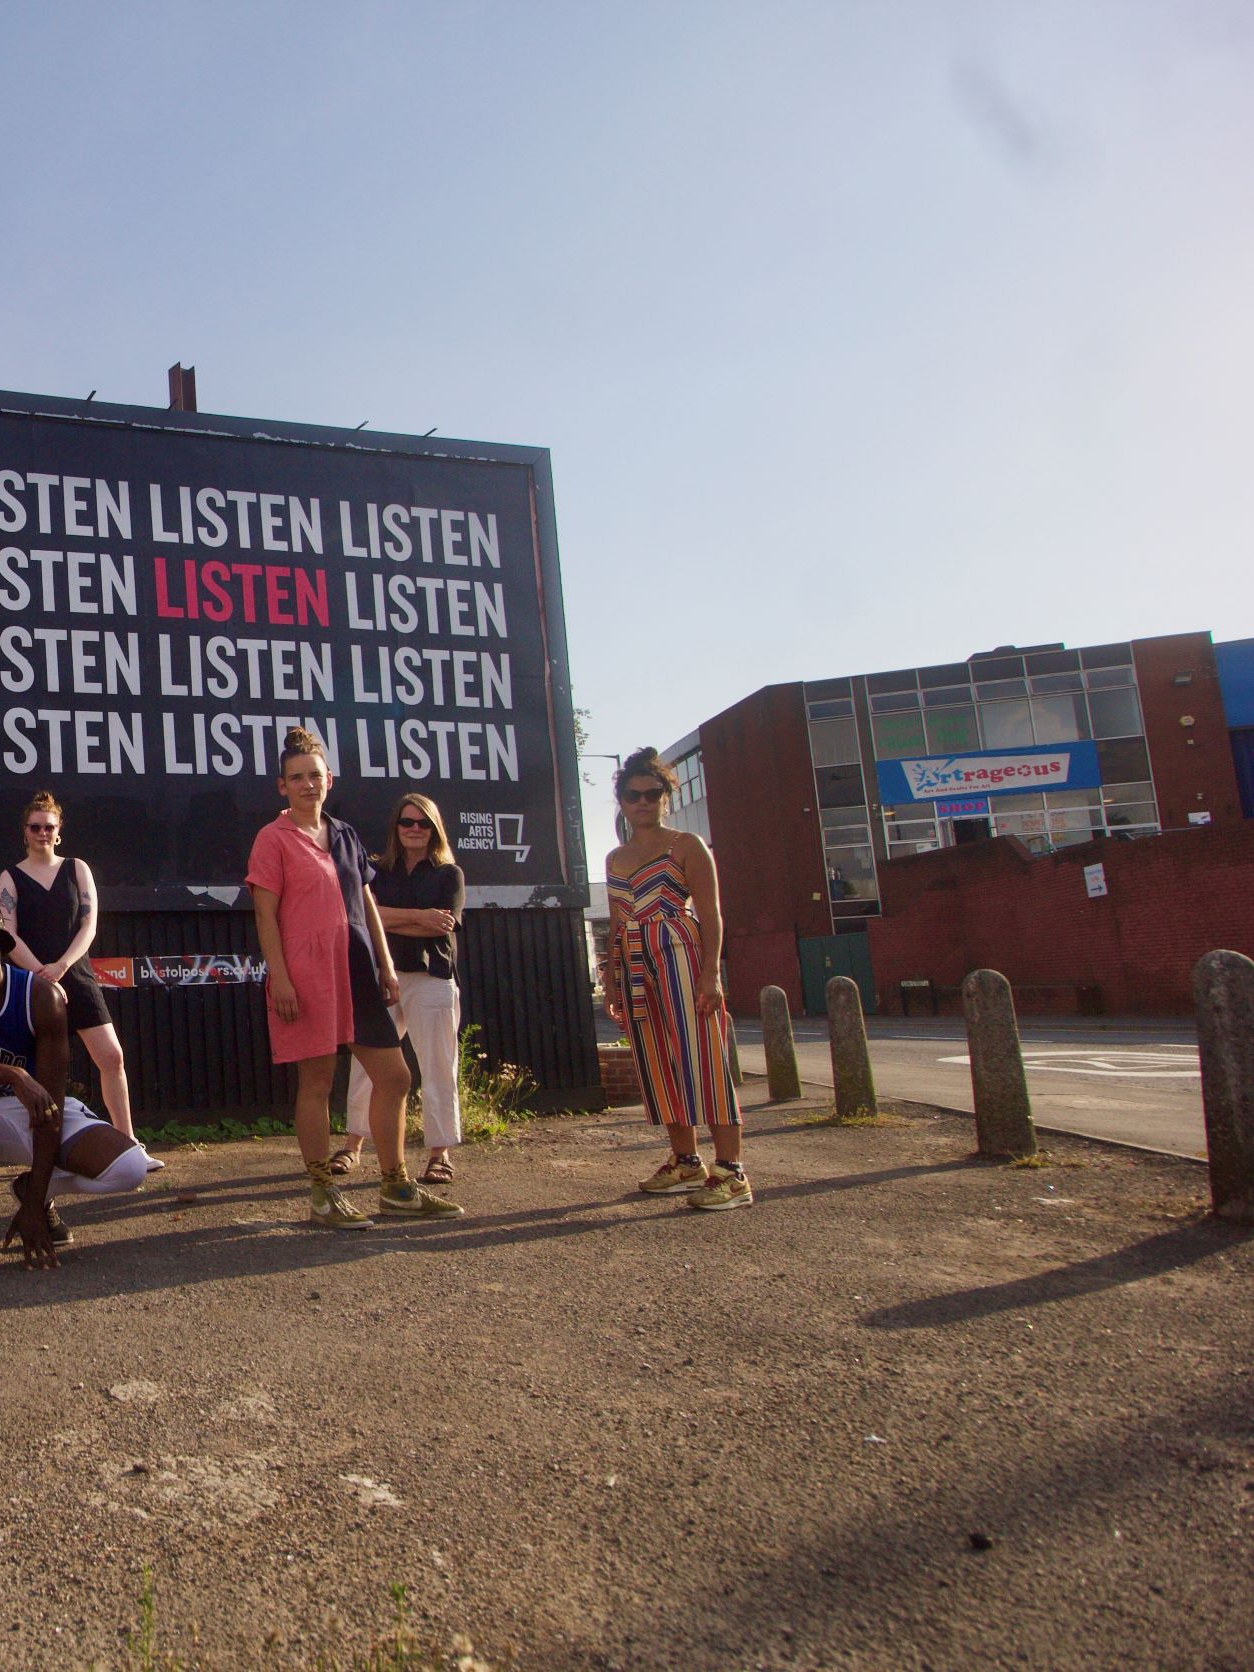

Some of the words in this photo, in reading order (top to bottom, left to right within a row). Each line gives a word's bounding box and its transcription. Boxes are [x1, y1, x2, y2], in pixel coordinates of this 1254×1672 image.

[150, 484, 323, 554] LISTEN
[340, 501, 500, 568] LISTEN
[154, 558, 329, 626] LISTEN
[346, 572, 507, 637] LISTEN
[159, 634, 334, 701] LISTEN
[351, 645, 512, 709] LISTEN
[356, 719, 518, 781] LISTEN
[916, 760, 1061, 787] Artrageous
[460, 812, 493, 824] RISING
[940, 802, 985, 813] SHOP
[458, 838, 494, 850] AGENCY
[469, 825, 494, 837] ARTS
